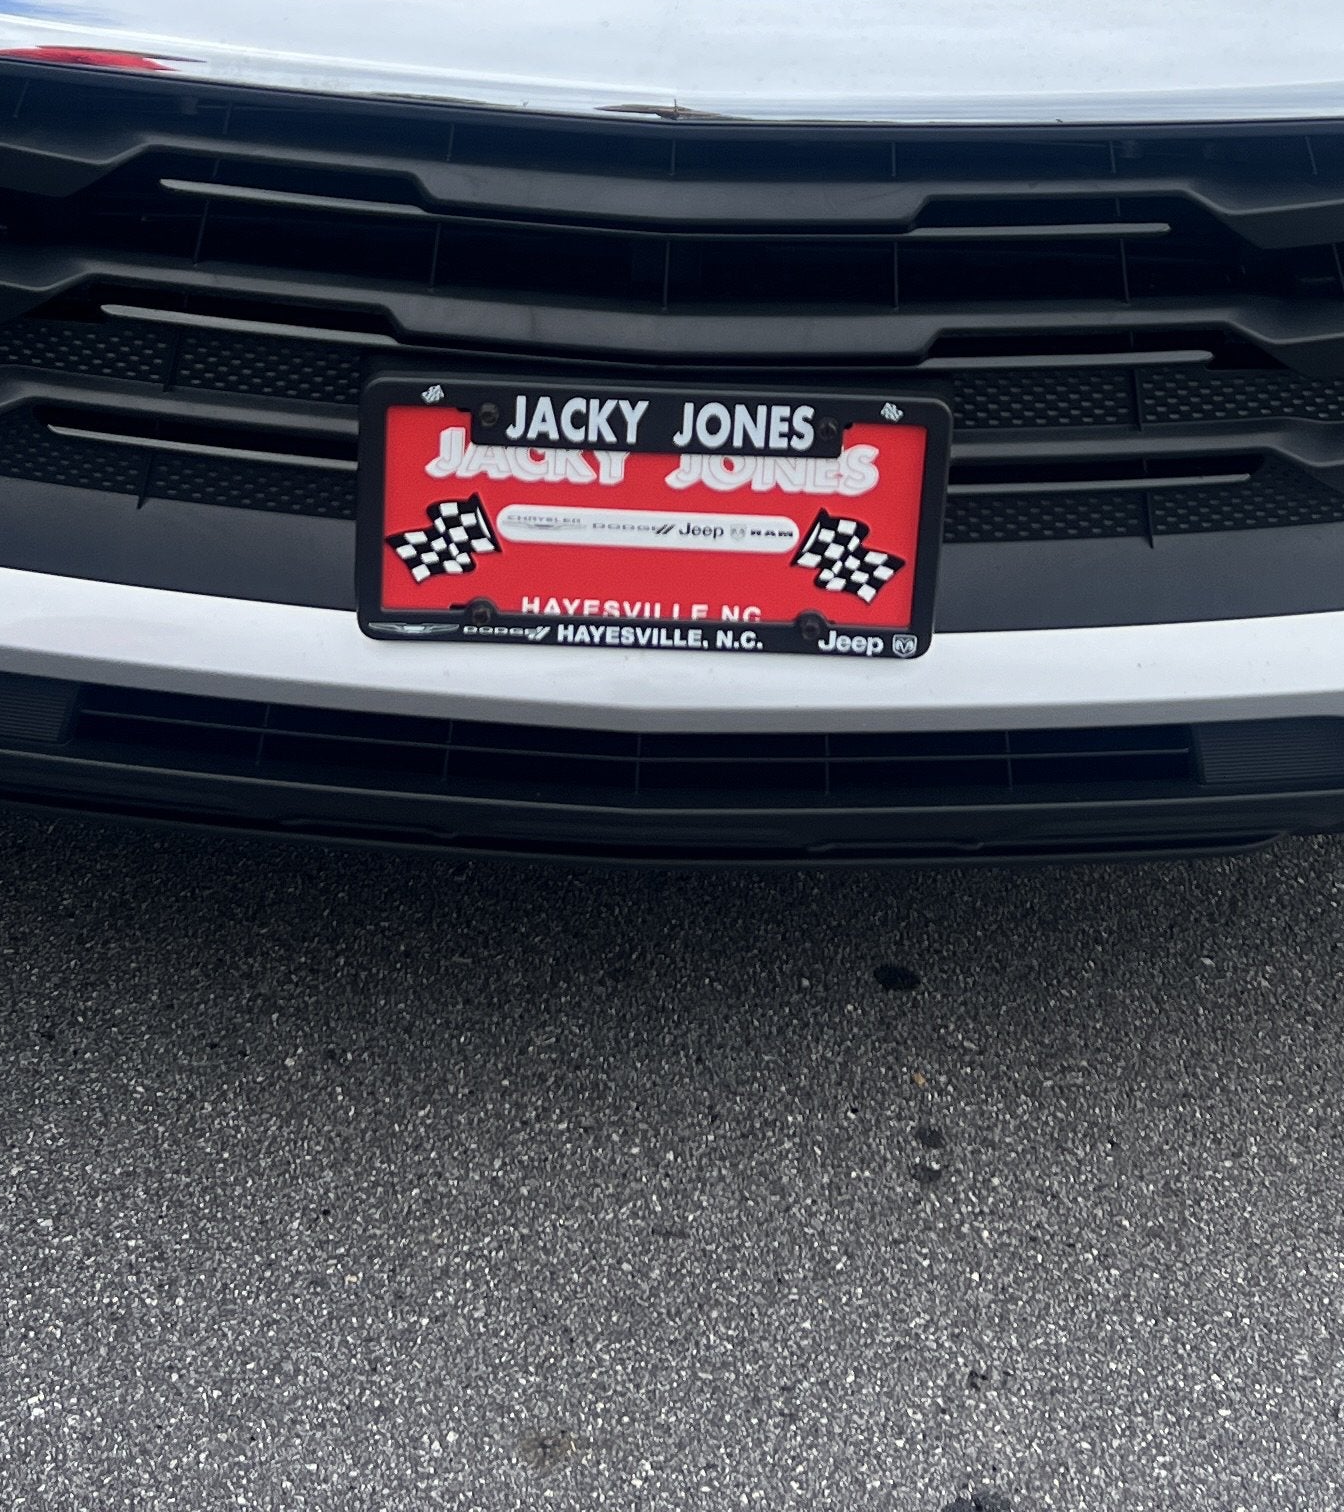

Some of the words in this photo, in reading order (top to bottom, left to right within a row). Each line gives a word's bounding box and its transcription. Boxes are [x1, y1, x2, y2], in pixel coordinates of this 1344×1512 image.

[506, 395, 649, 444] JACKY
[672, 402, 815, 451] JONES
[679, 522, 724, 539] Jeep
[716, 629, 763, 650] N.C.
[818, 629, 884, 656] Jeep
